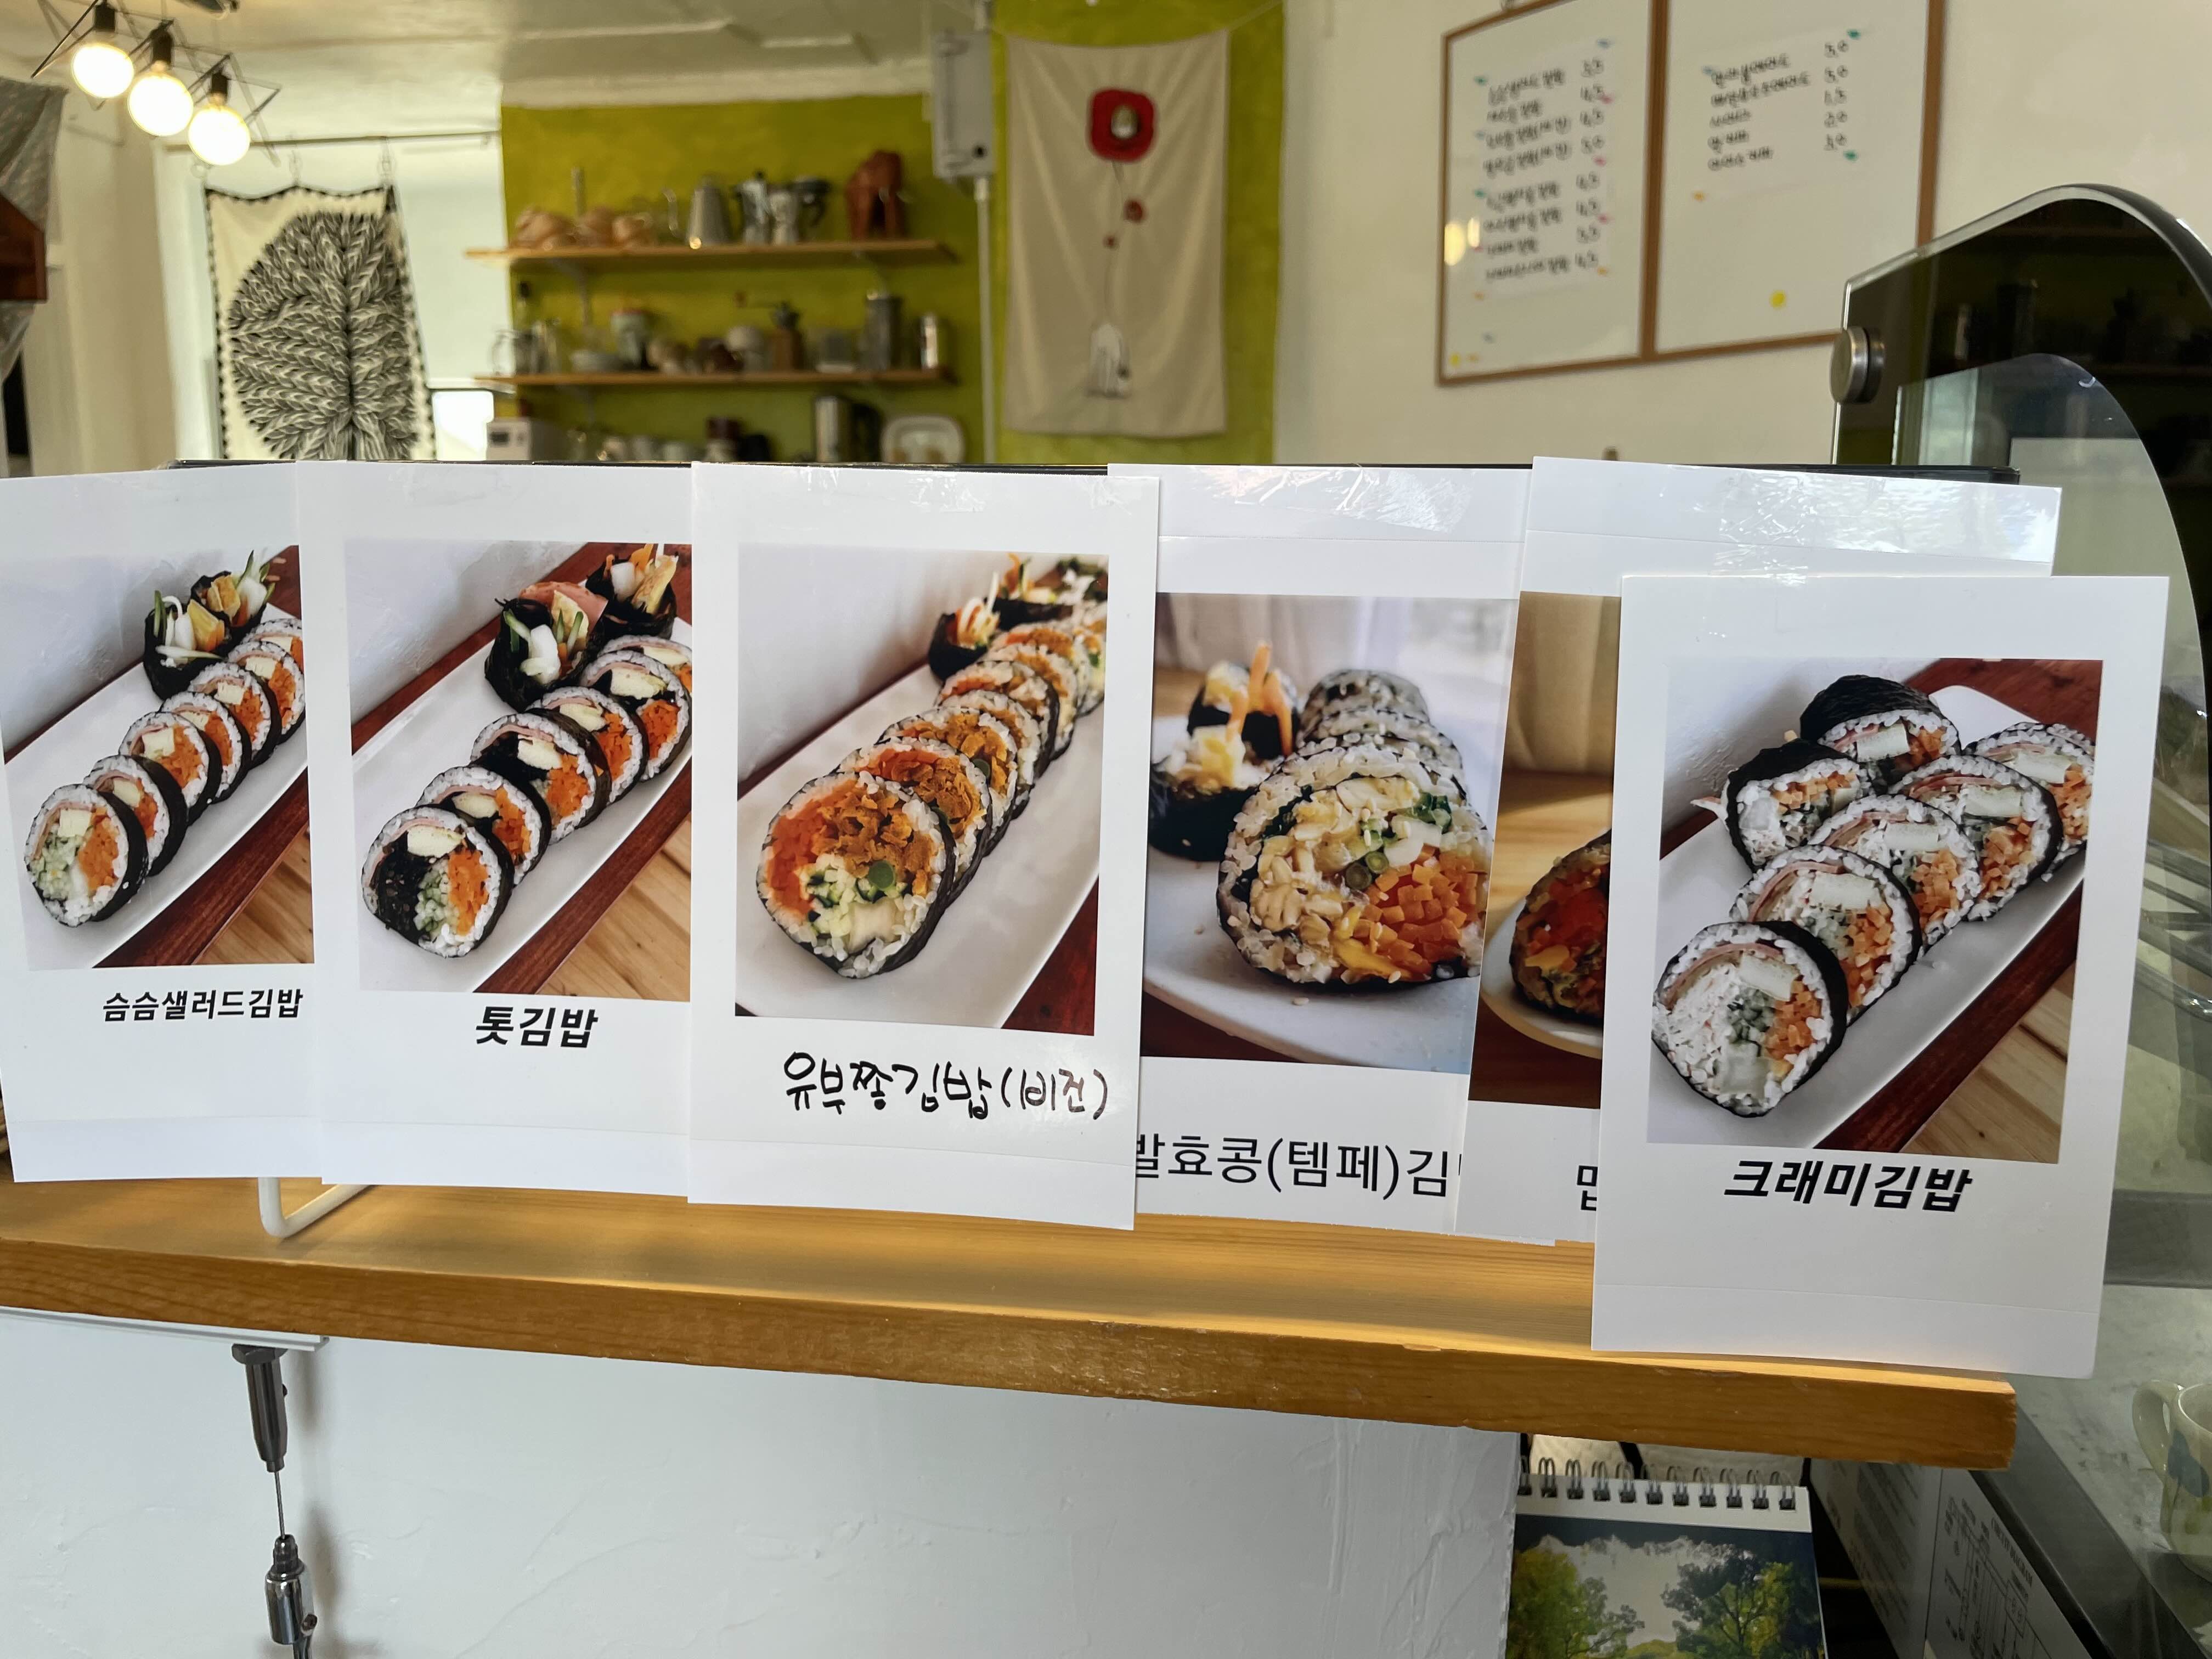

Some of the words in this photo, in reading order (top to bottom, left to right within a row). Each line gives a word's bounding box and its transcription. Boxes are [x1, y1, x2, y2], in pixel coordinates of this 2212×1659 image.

[103, 989, 303, 1022] 슴슴샐러드김밥
[476, 1006, 599, 1048] 톳김밥
[1136, 1133, 1462, 1200] 발효콩(템페)김
[1724, 1160, 1973, 1212] 크래미김밥
